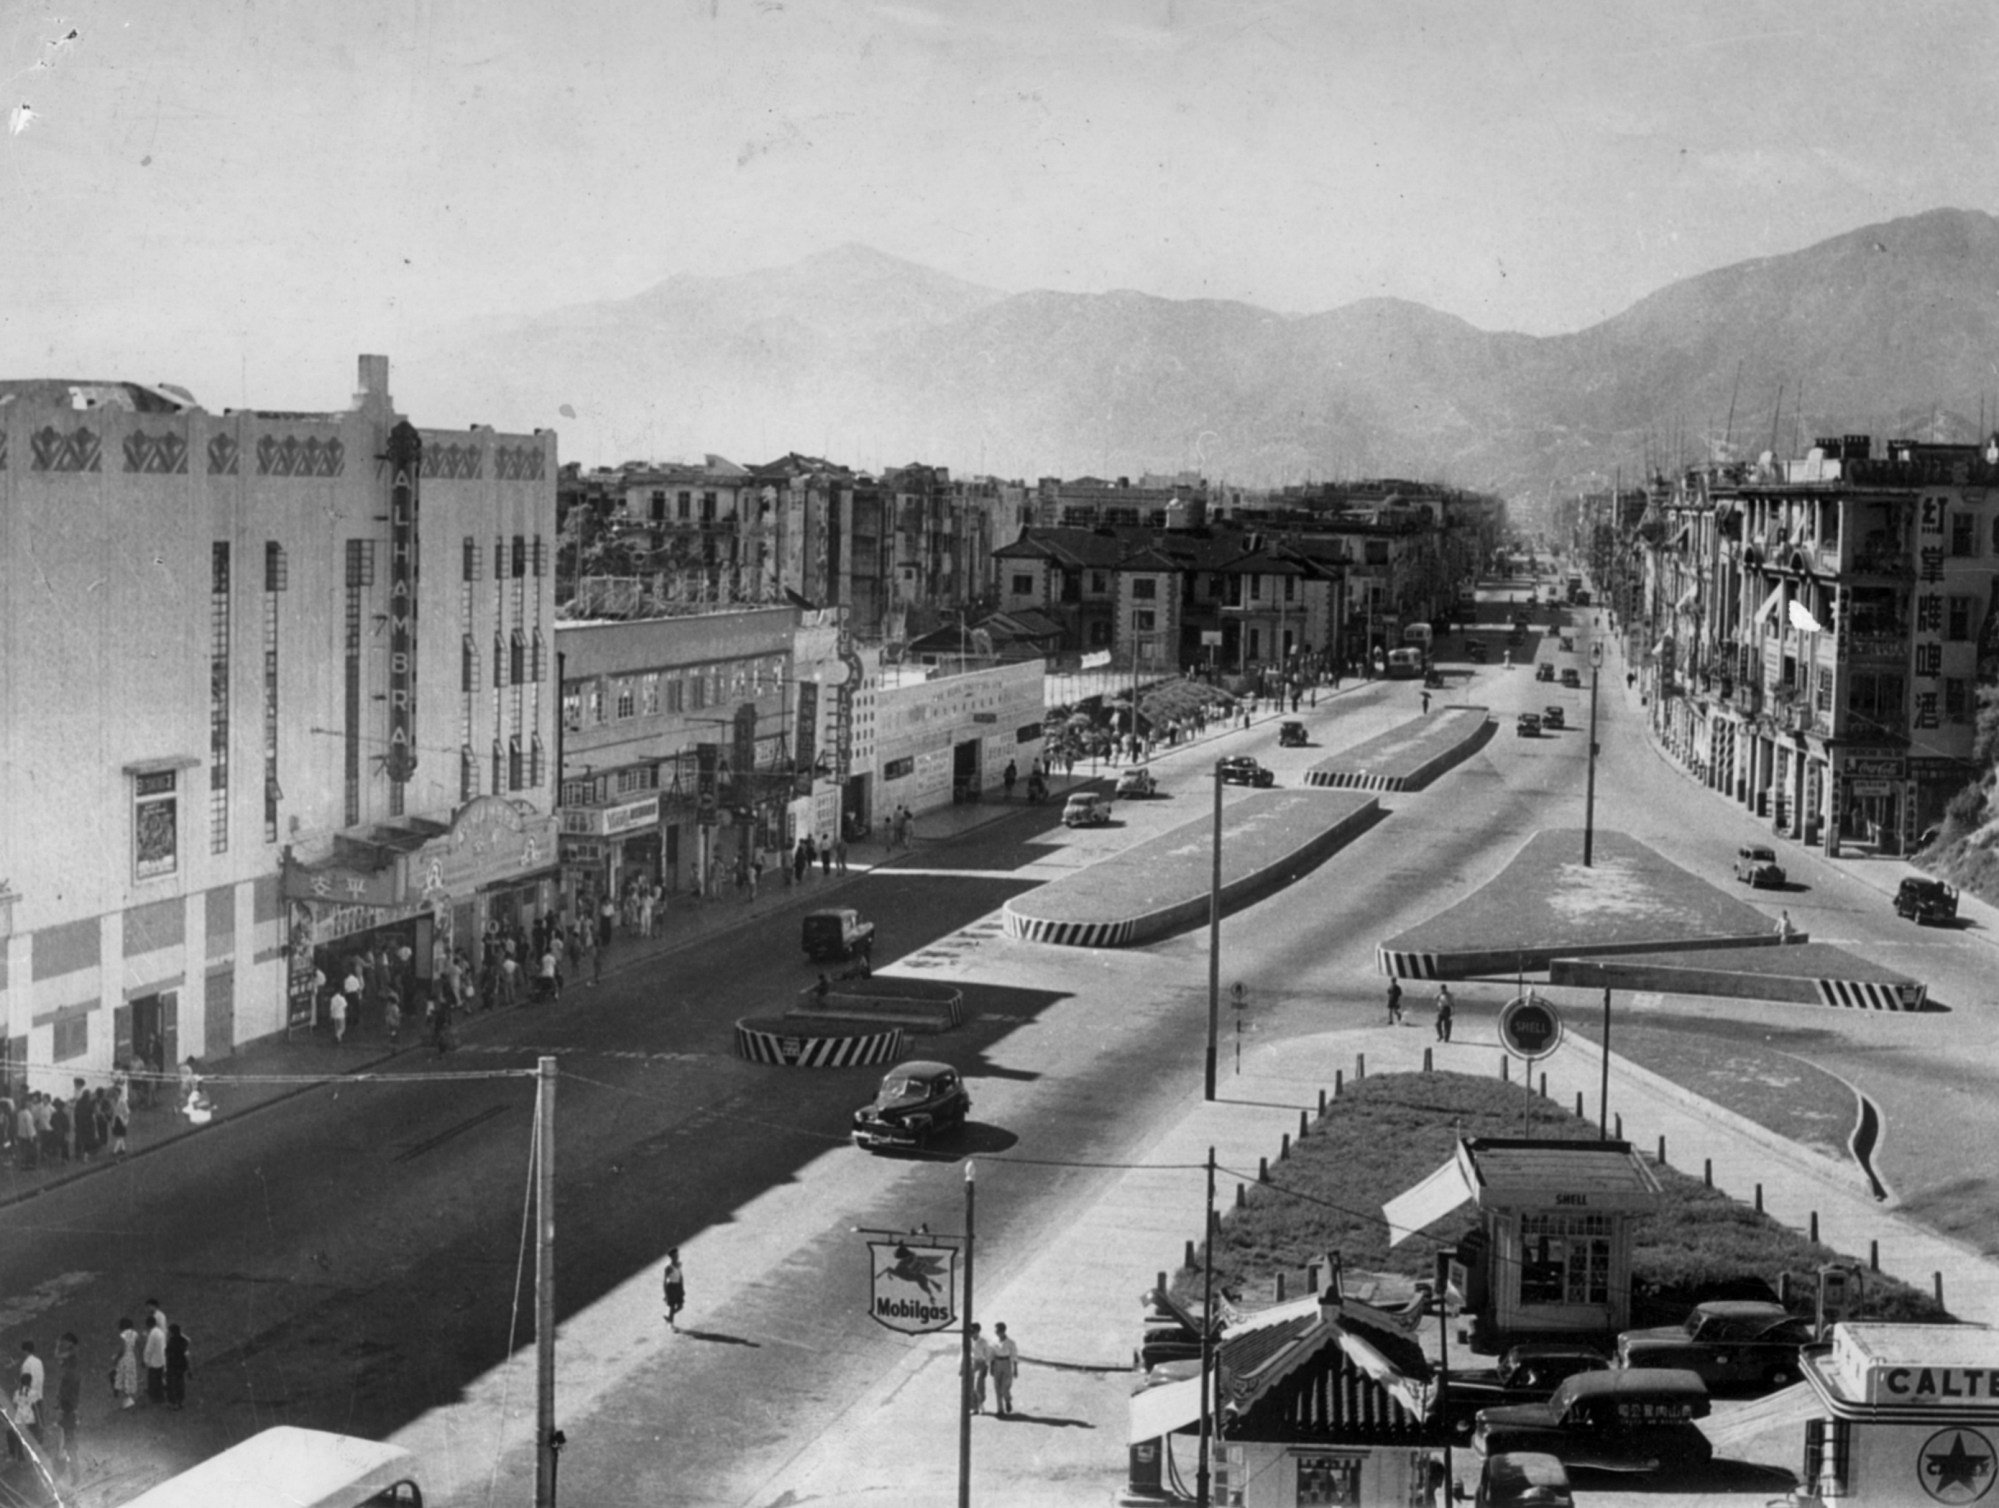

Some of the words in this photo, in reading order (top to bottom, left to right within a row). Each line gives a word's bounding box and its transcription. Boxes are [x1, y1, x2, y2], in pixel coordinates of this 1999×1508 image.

[391, 470, 410, 747] ALHAMBRA
[1913, 496, 1949, 730] 紅掌牌啤酒
[839, 607, 851, 655] BLUE
[1515, 1020, 1547, 1035] SHELL
[1555, 1193, 1589, 1206] SHELL
[876, 1296, 950, 1325] Mobilgas
